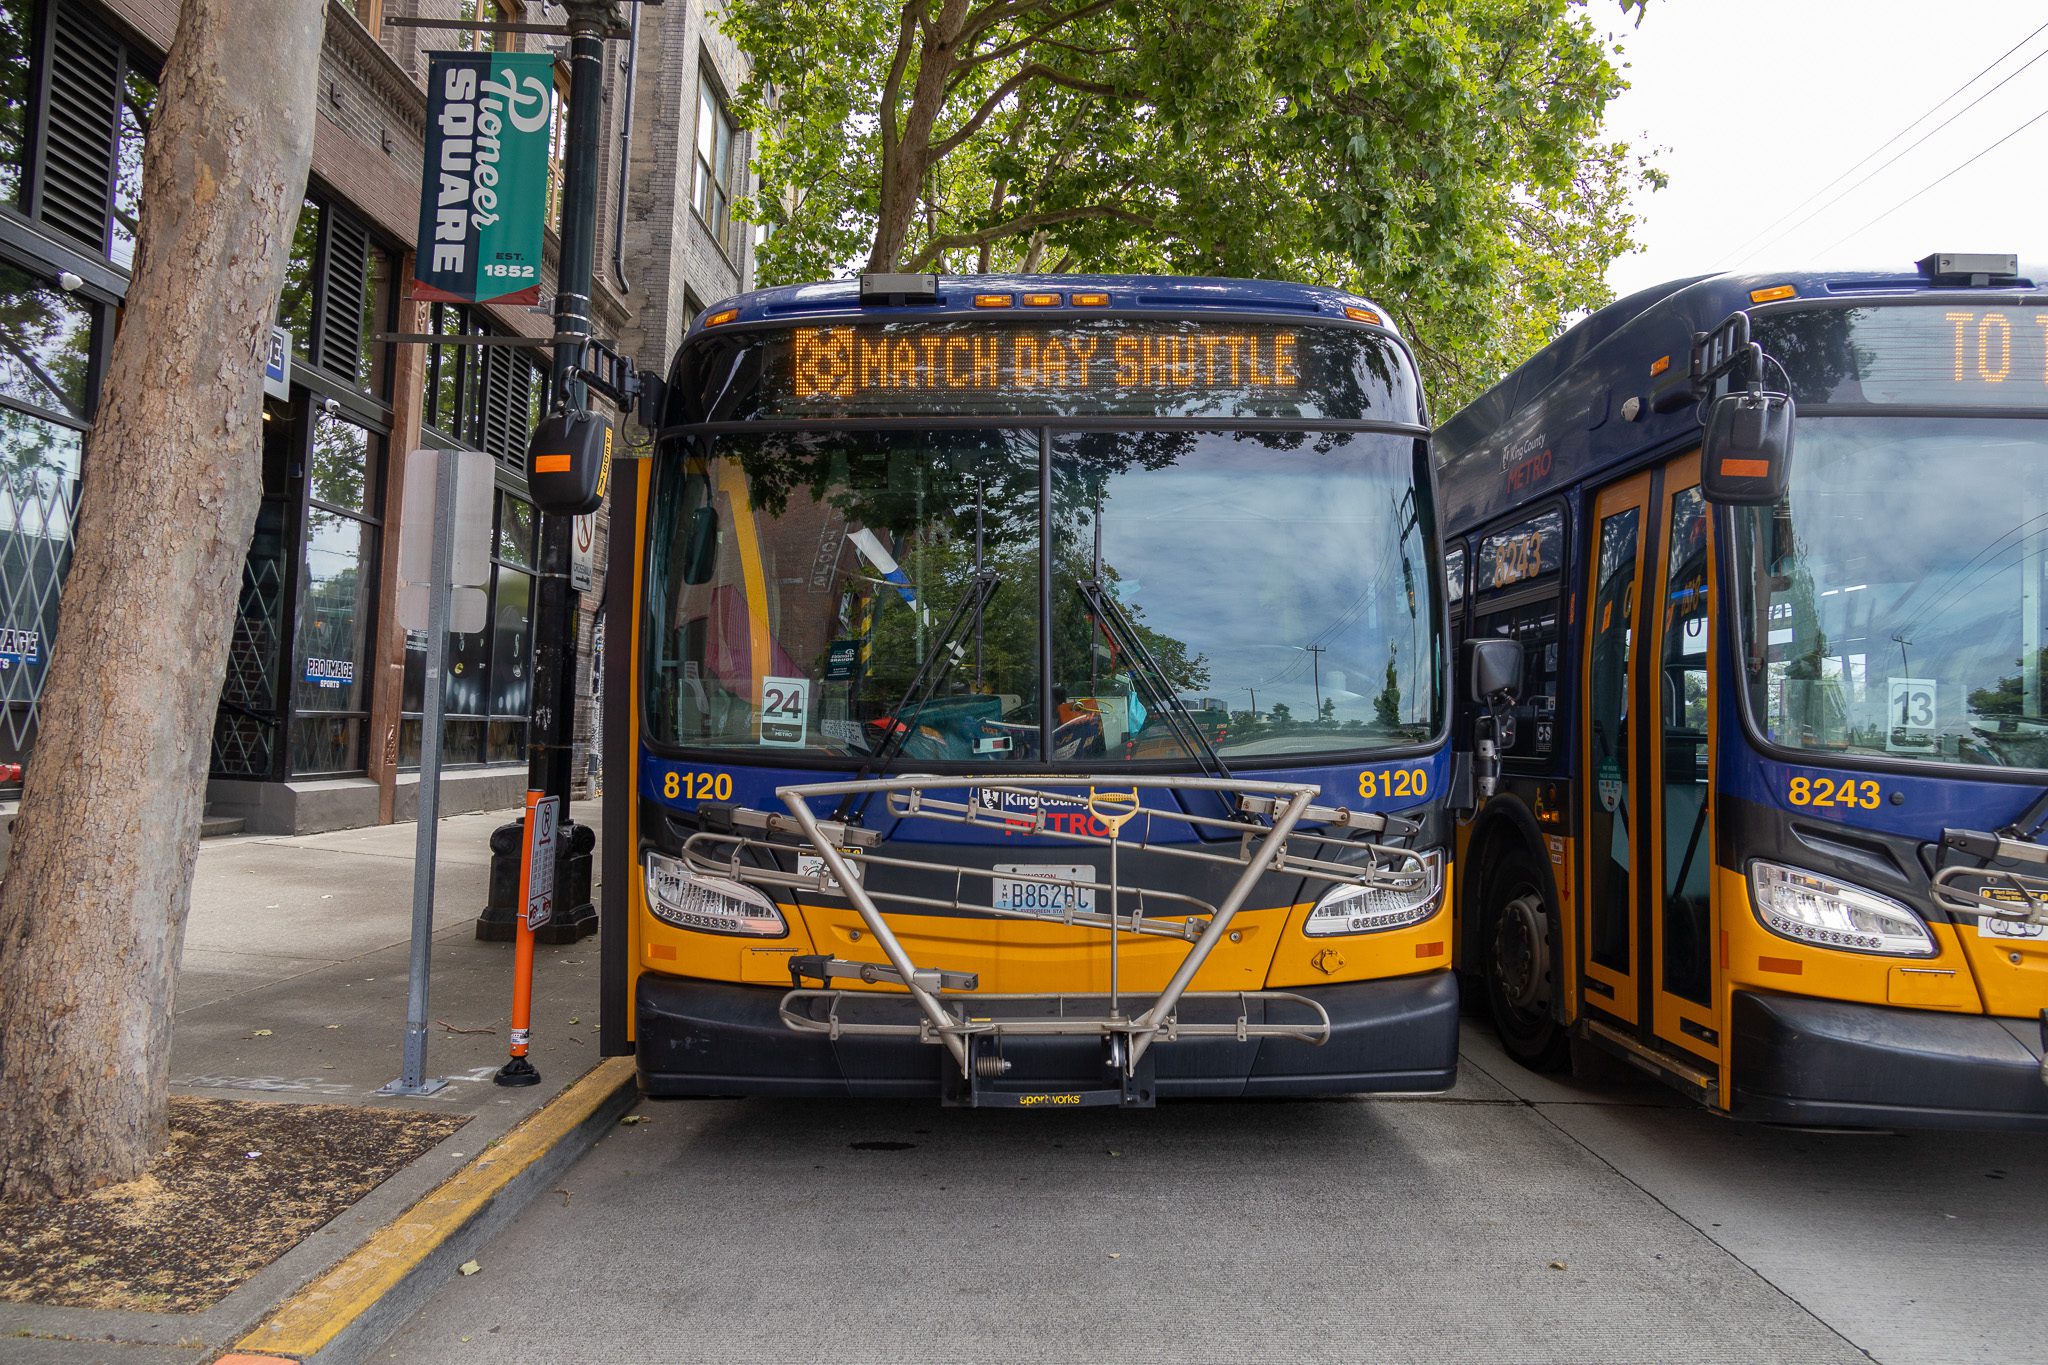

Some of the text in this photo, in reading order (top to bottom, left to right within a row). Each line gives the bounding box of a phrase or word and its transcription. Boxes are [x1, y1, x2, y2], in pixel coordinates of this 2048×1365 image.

[471, 68, 549, 231] Pioneer
[432, 68, 477, 273] SQUARE
[484, 264, 535, 278] 1852
[495, 252, 524, 261] EST.
[861, 334, 1296, 388] MATCH DAY SHUTTLE
[1945, 312, 2010, 382] TO
[1506, 450, 1552, 494] METRO
[1493, 531, 1542, 588] 8243
[0, 628, 38, 656] AGE
[307, 658, 353, 679] PRO IMAGE
[763, 689, 802, 719] 24
[1894, 691, 1933, 727] 13
[664, 772, 732, 800] 8120
[1359, 769, 1427, 798] 8120
[1788, 777, 1881, 809] 8243
[1005, 793, 1038, 809] King
